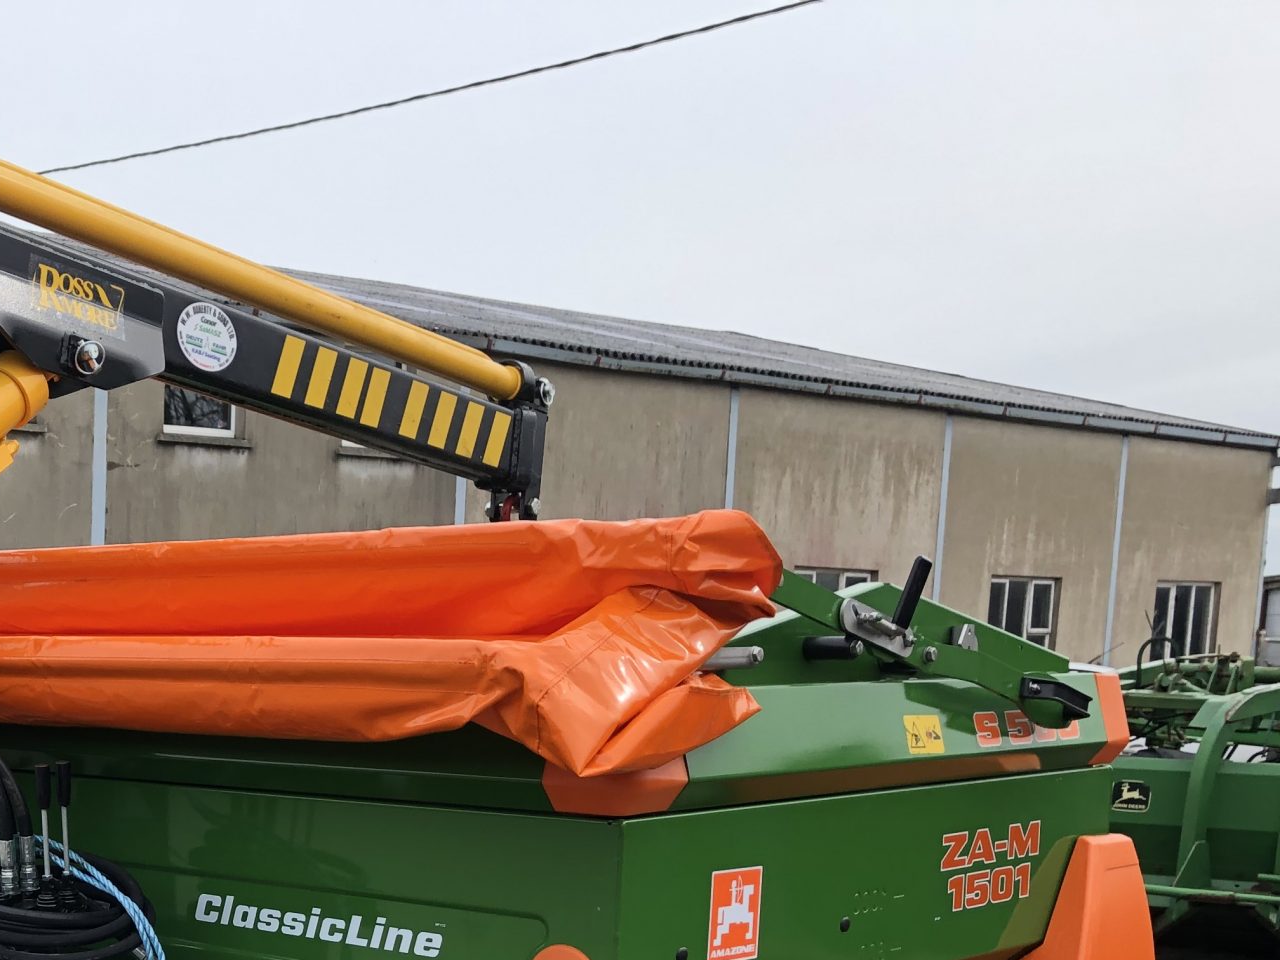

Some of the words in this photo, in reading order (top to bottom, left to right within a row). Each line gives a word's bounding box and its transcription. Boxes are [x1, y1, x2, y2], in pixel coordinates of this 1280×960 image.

[941, 820, 1041, 872] ZA-M
[947, 862, 1031, 912] 1501
[194, 893, 443, 958] ClassicLine
[711, 943, 755, 958] AMAZONE
